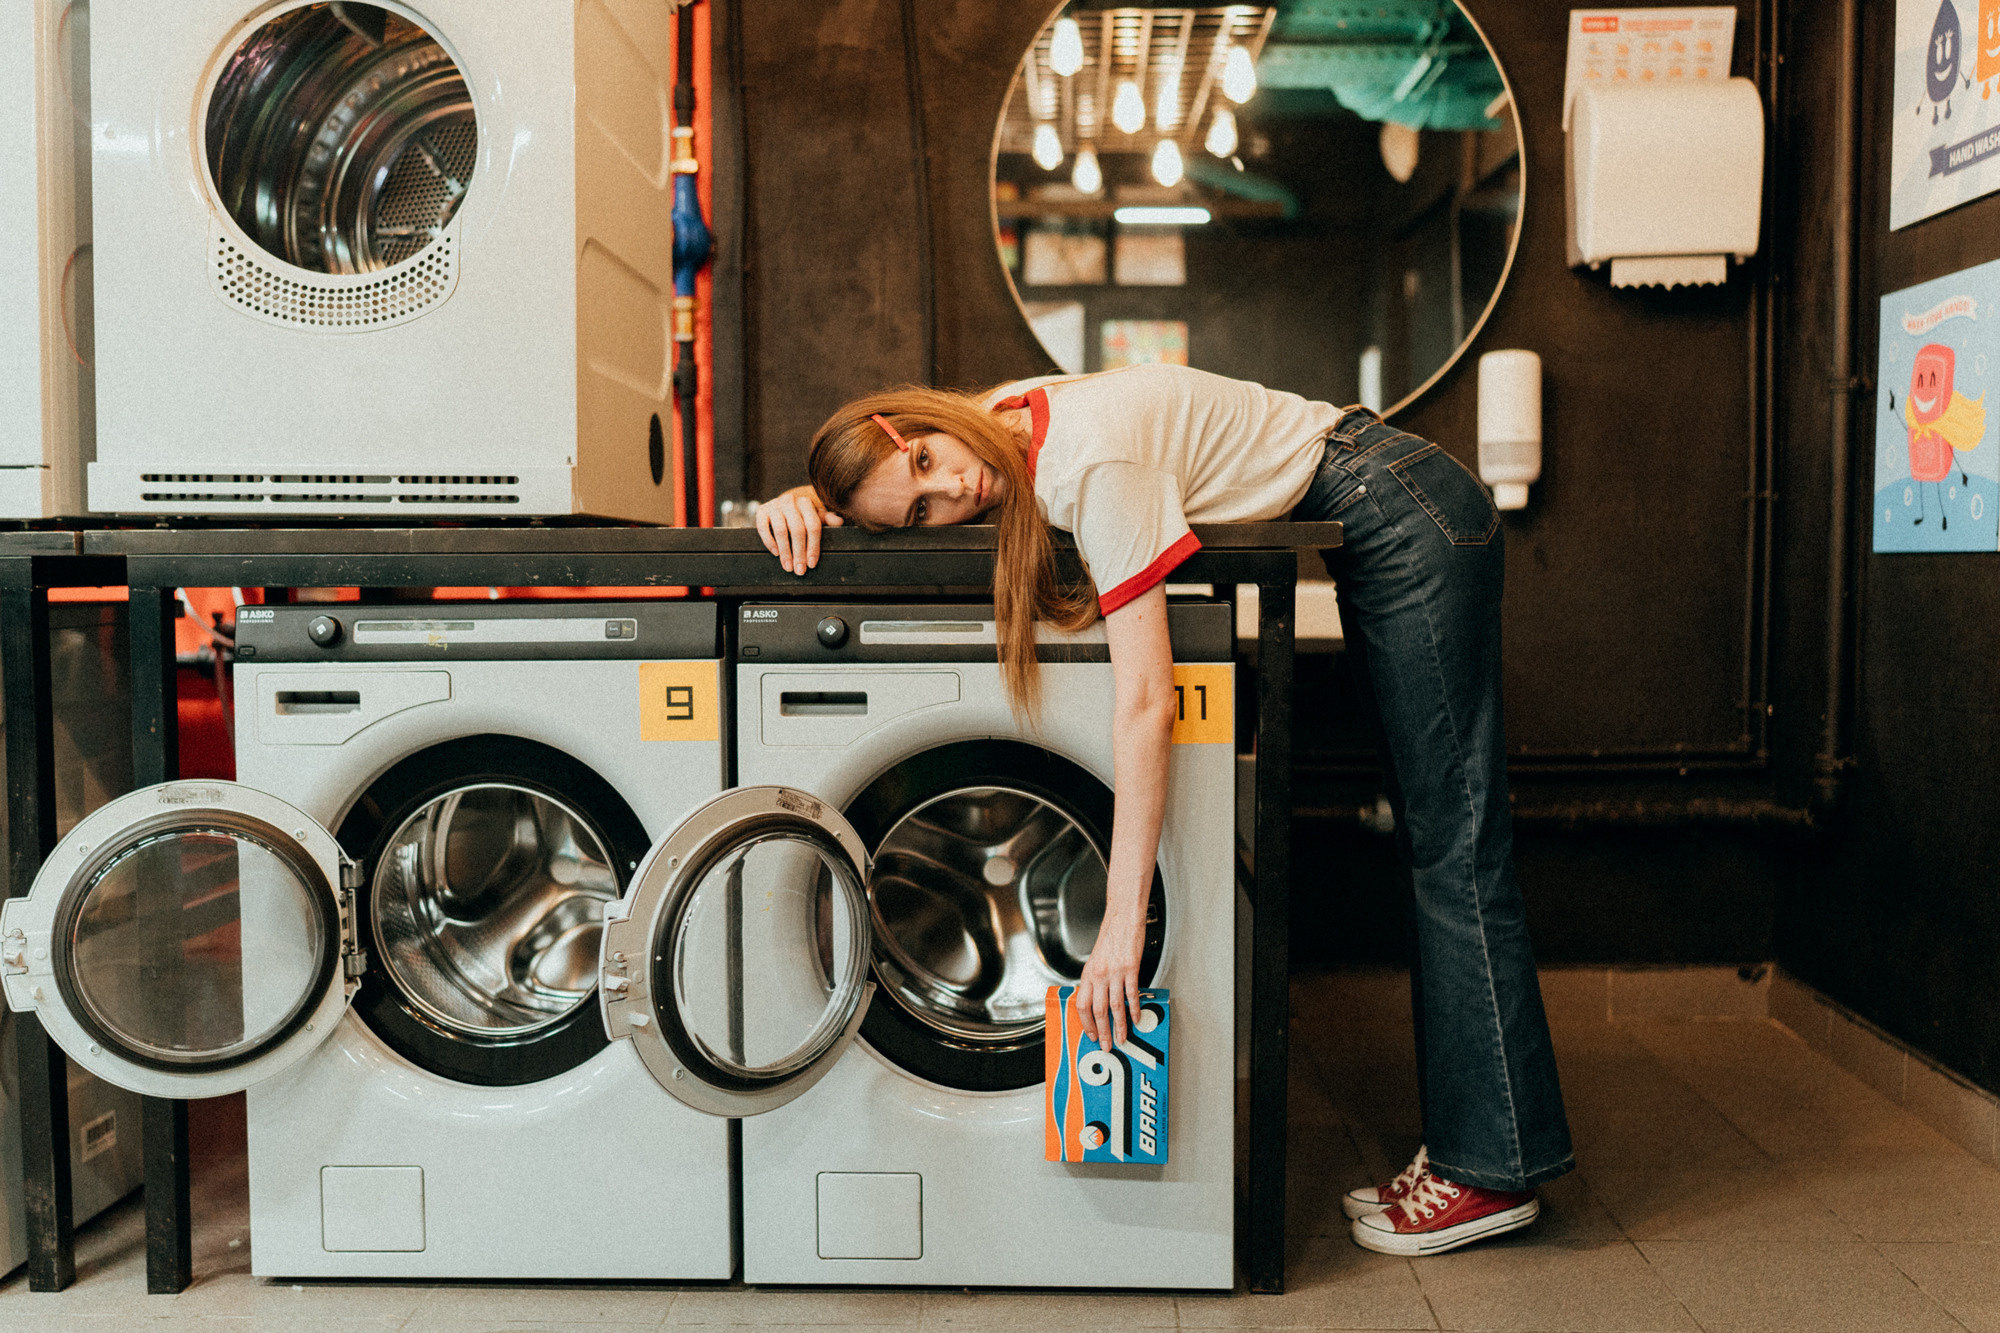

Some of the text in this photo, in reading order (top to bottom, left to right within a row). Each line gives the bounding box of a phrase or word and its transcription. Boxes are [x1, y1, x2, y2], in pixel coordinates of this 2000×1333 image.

[1949, 142, 1974, 168] HAND
[249, 610, 275, 619] ASKO
[752, 610, 778, 618] ASKO
[667, 686, 693, 720] 9
[1174, 685, 1207, 720] 11
